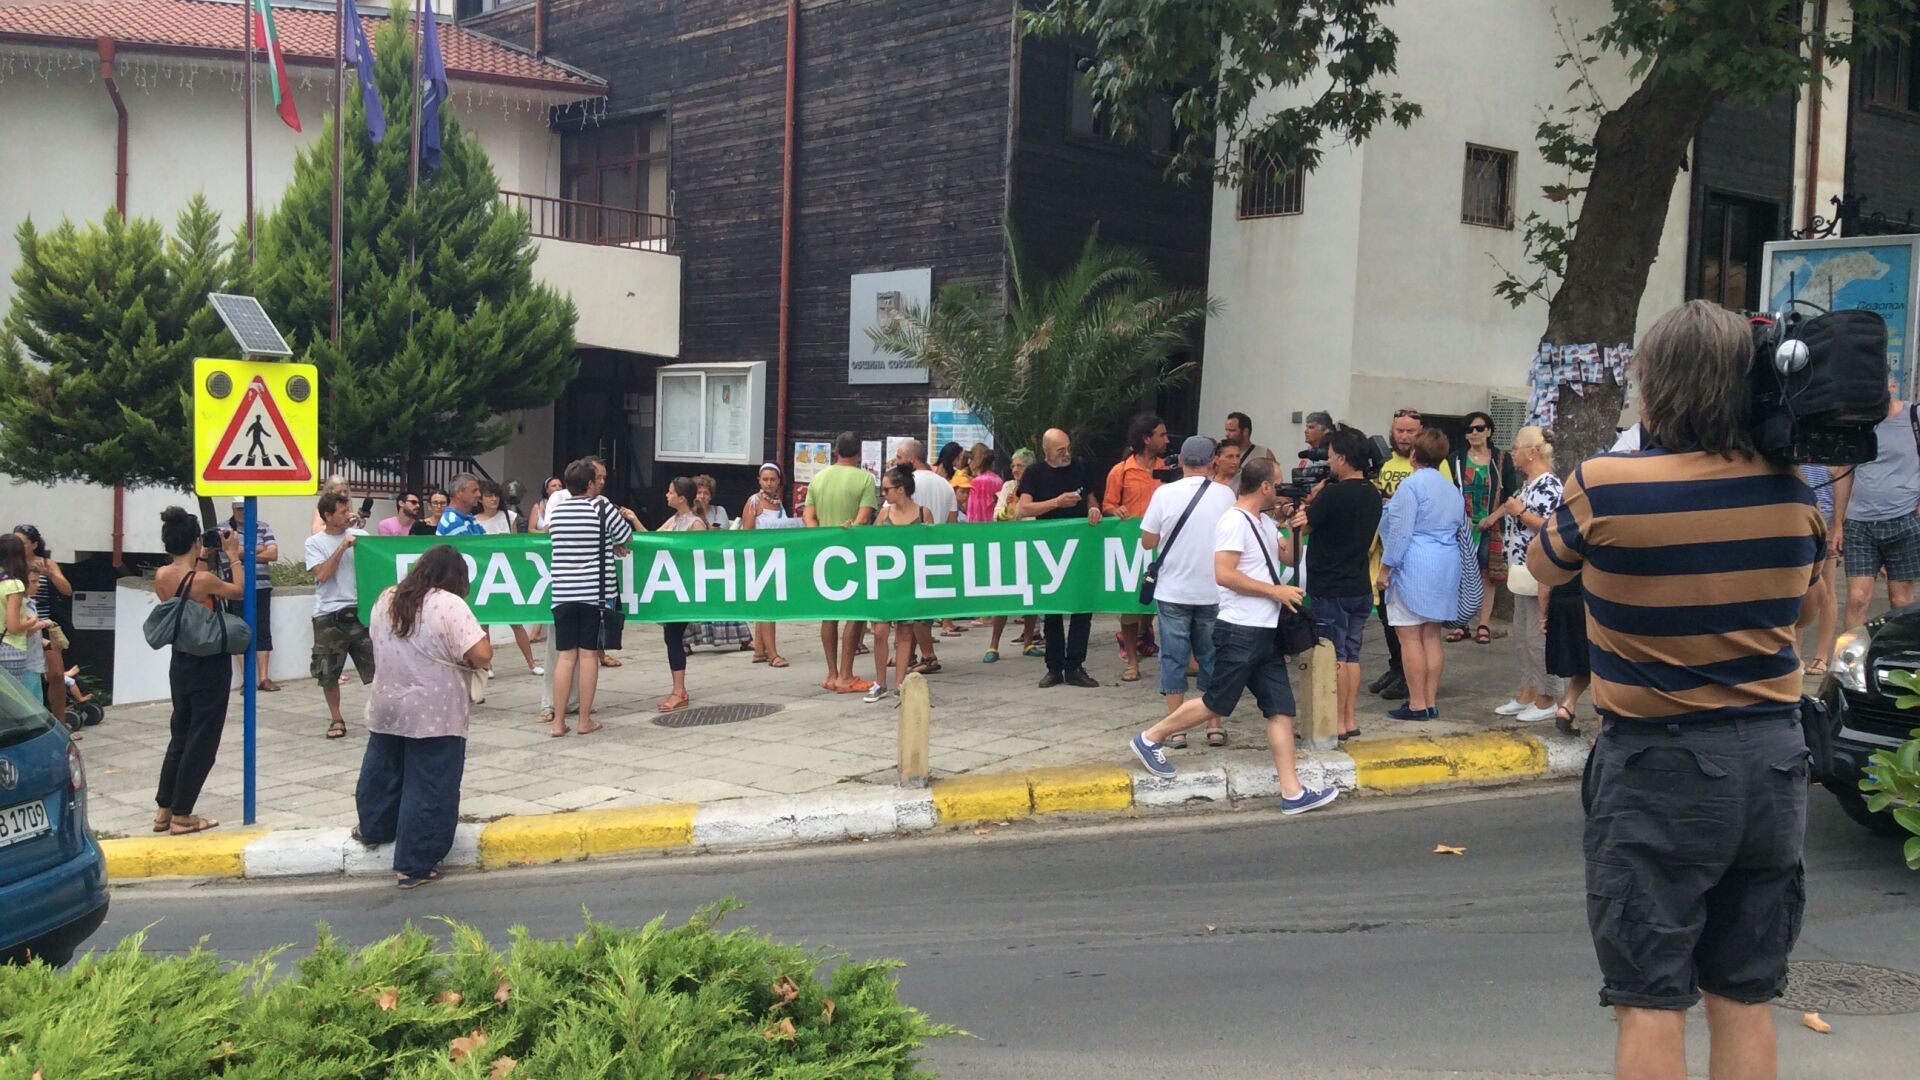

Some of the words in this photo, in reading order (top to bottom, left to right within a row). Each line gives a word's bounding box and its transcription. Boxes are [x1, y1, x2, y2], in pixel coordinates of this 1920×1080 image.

[396, 547, 788, 615] ГААНИ
[812, 538, 1080, 606] СРЕЩУ
[10, 803, 45, 834] 1709
